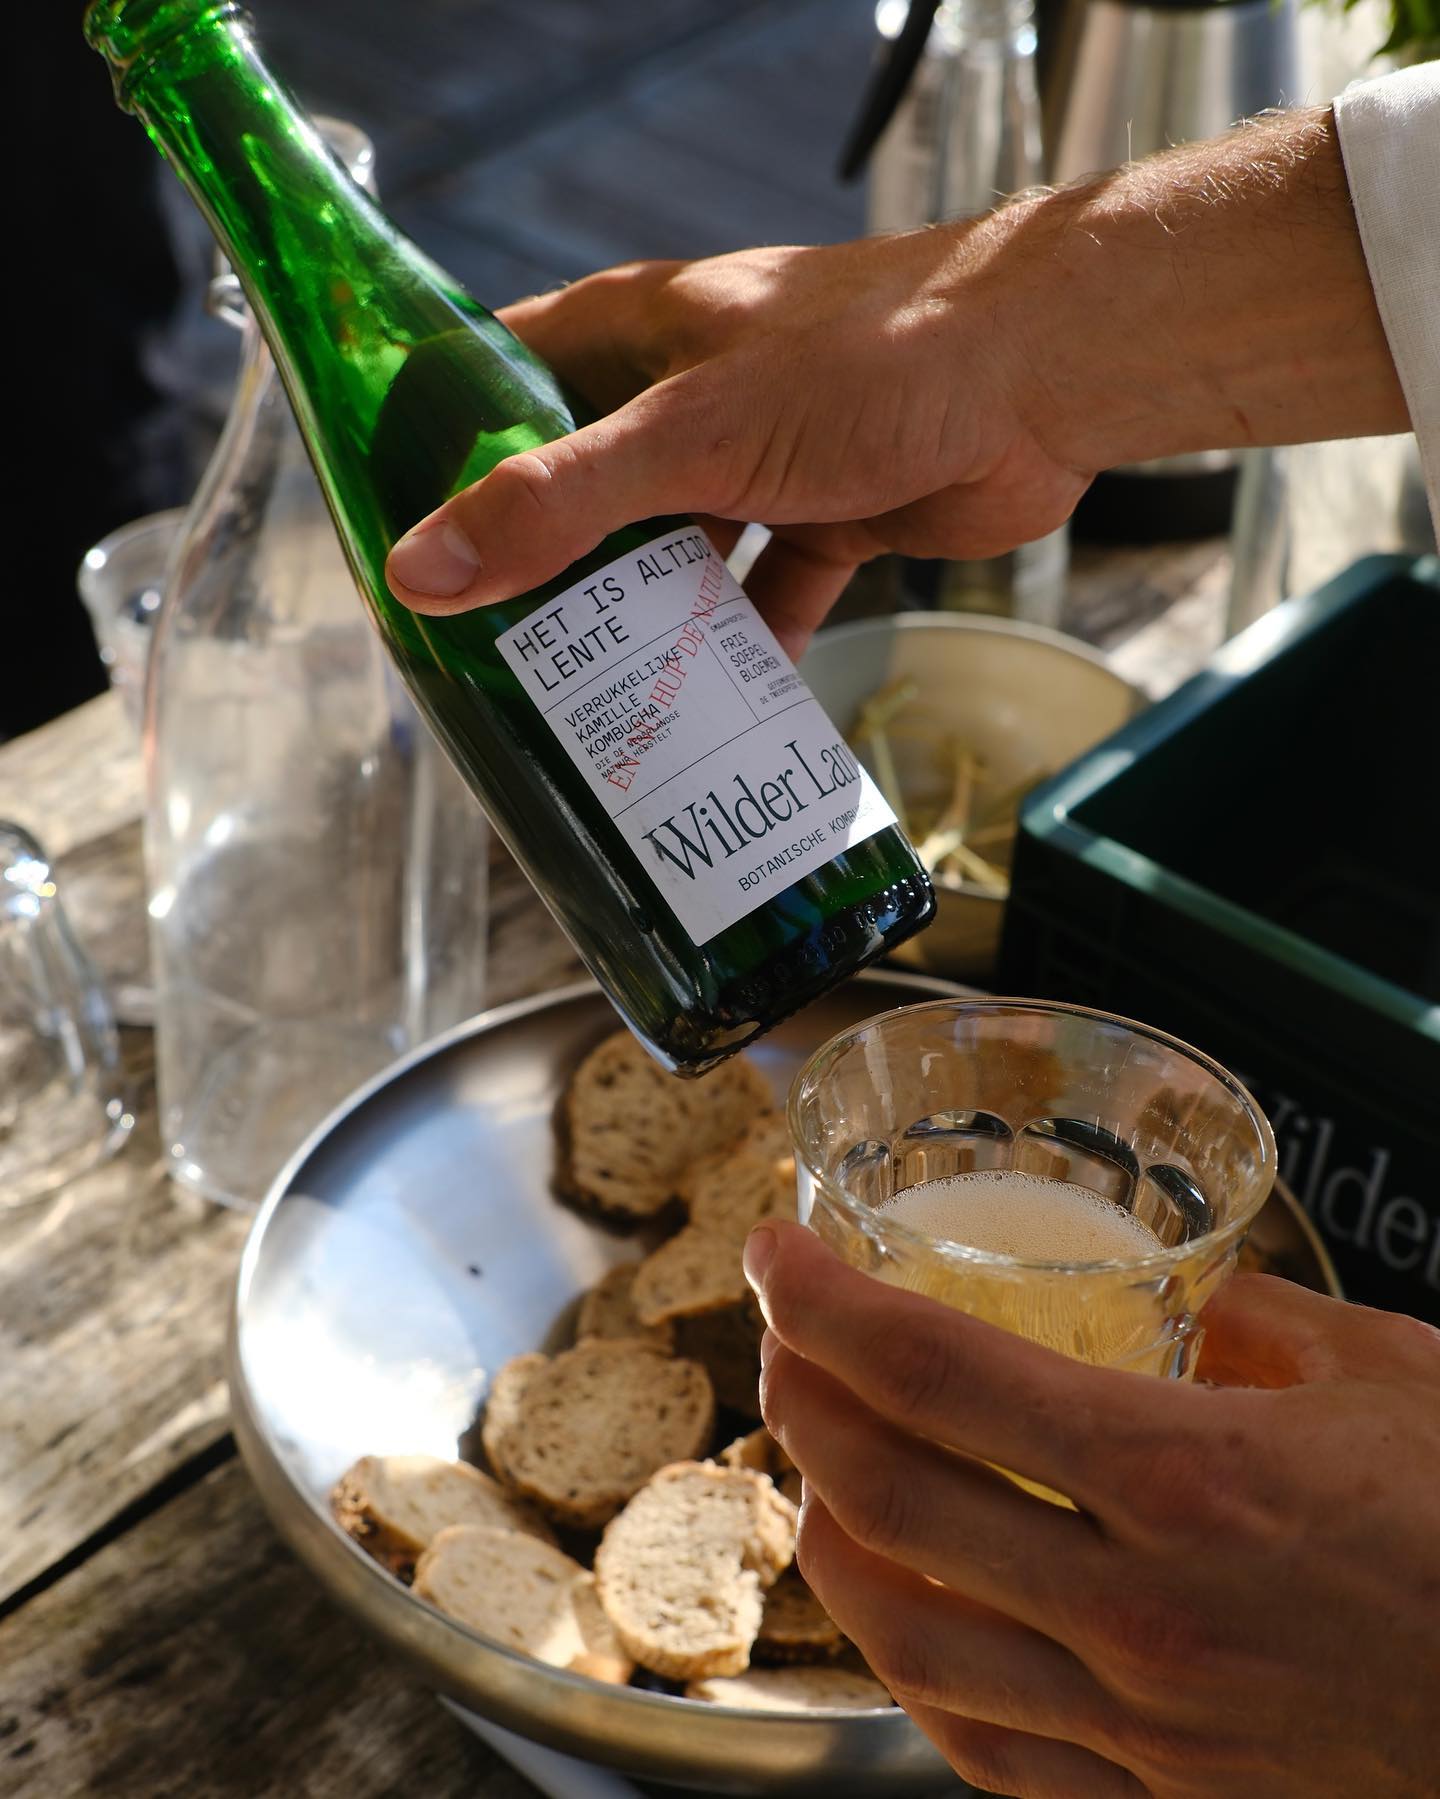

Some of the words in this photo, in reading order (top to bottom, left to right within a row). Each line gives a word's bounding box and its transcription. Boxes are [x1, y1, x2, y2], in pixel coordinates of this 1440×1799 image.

[513, 607, 569, 661] HET
[583, 577, 625, 614] IS
[636, 535, 711, 585] ALTIJD
[534, 616, 629, 691] LENTE
[720, 632, 748, 653] FRIS
[730, 643, 767, 668] SOEPEL
[740, 656, 782, 683] BLOEMEN
[564, 647, 683, 728] VERRUKKELIJKE
[606, 750, 640, 792] EN
[649, 654, 687, 709] HUP
[675, 622, 704, 658] DE
[575, 693, 641, 744] KAMILLE
[585, 703, 661, 759] KOMBUCHA
[595, 756, 611, 770] DIE
[613, 746, 624, 758] DE
[627, 710, 681, 748] NEDERLANDSE
[633, 727, 673, 757] HERSTELT
[641, 768, 809, 880] Wilder
[784, 740, 862, 799] Lan
[738, 828, 826, 891] BOTANISCHE
